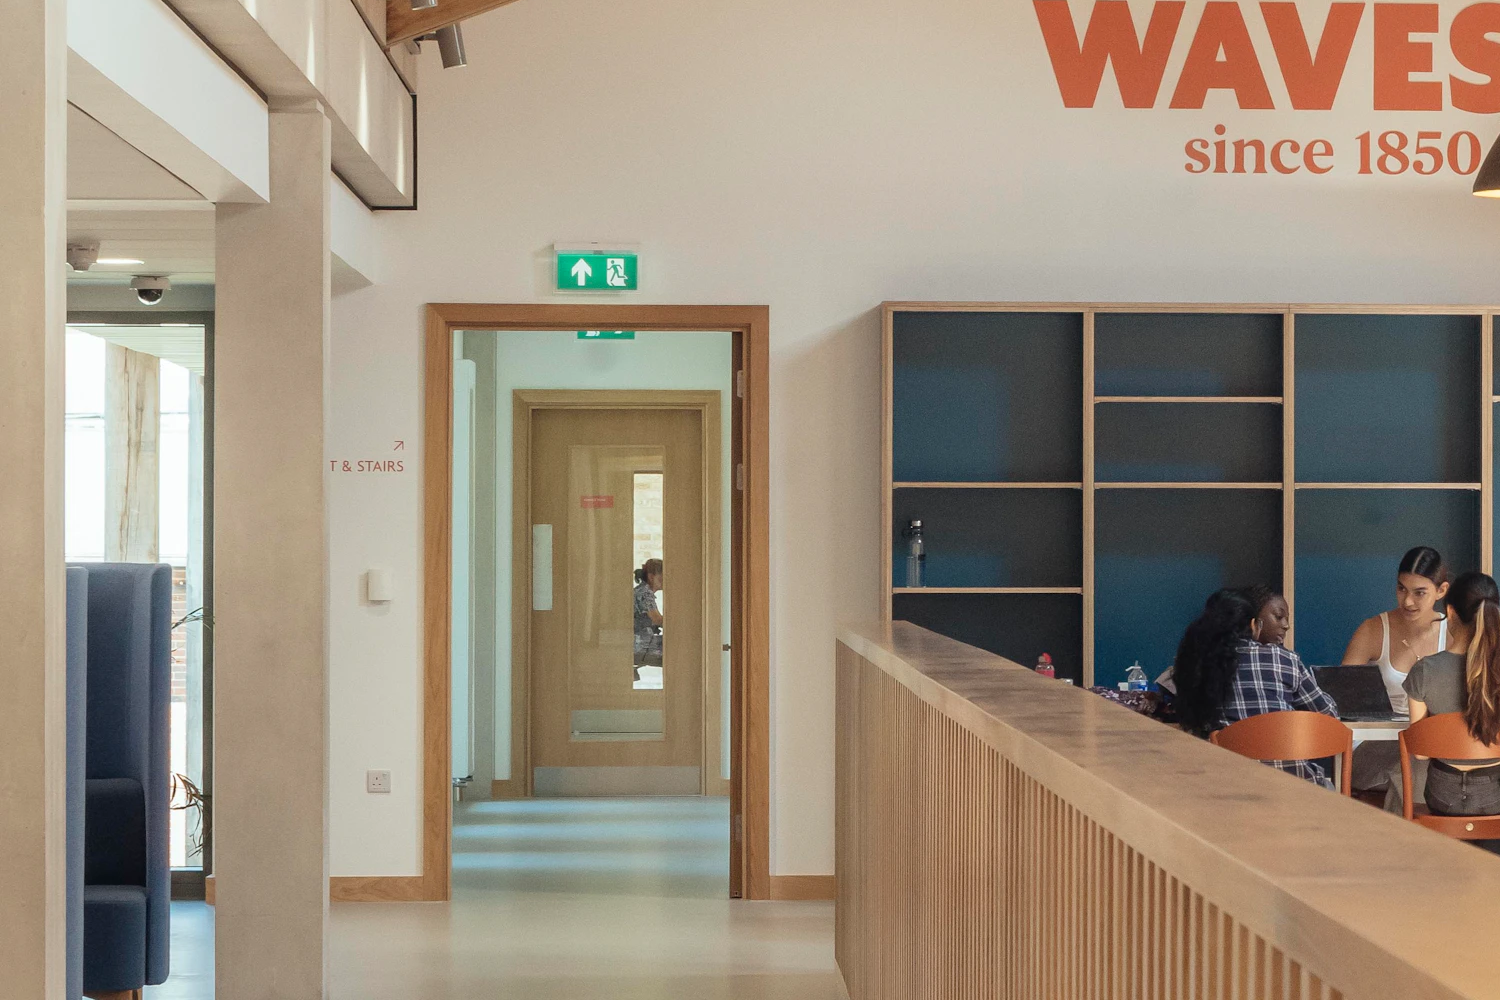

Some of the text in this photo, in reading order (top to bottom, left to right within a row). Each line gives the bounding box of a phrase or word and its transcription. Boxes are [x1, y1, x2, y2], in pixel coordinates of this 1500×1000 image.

[1184, 123, 1482, 176] since 1850
[342, 460, 352, 472] &
[357, 460, 404, 472] STAIRS
